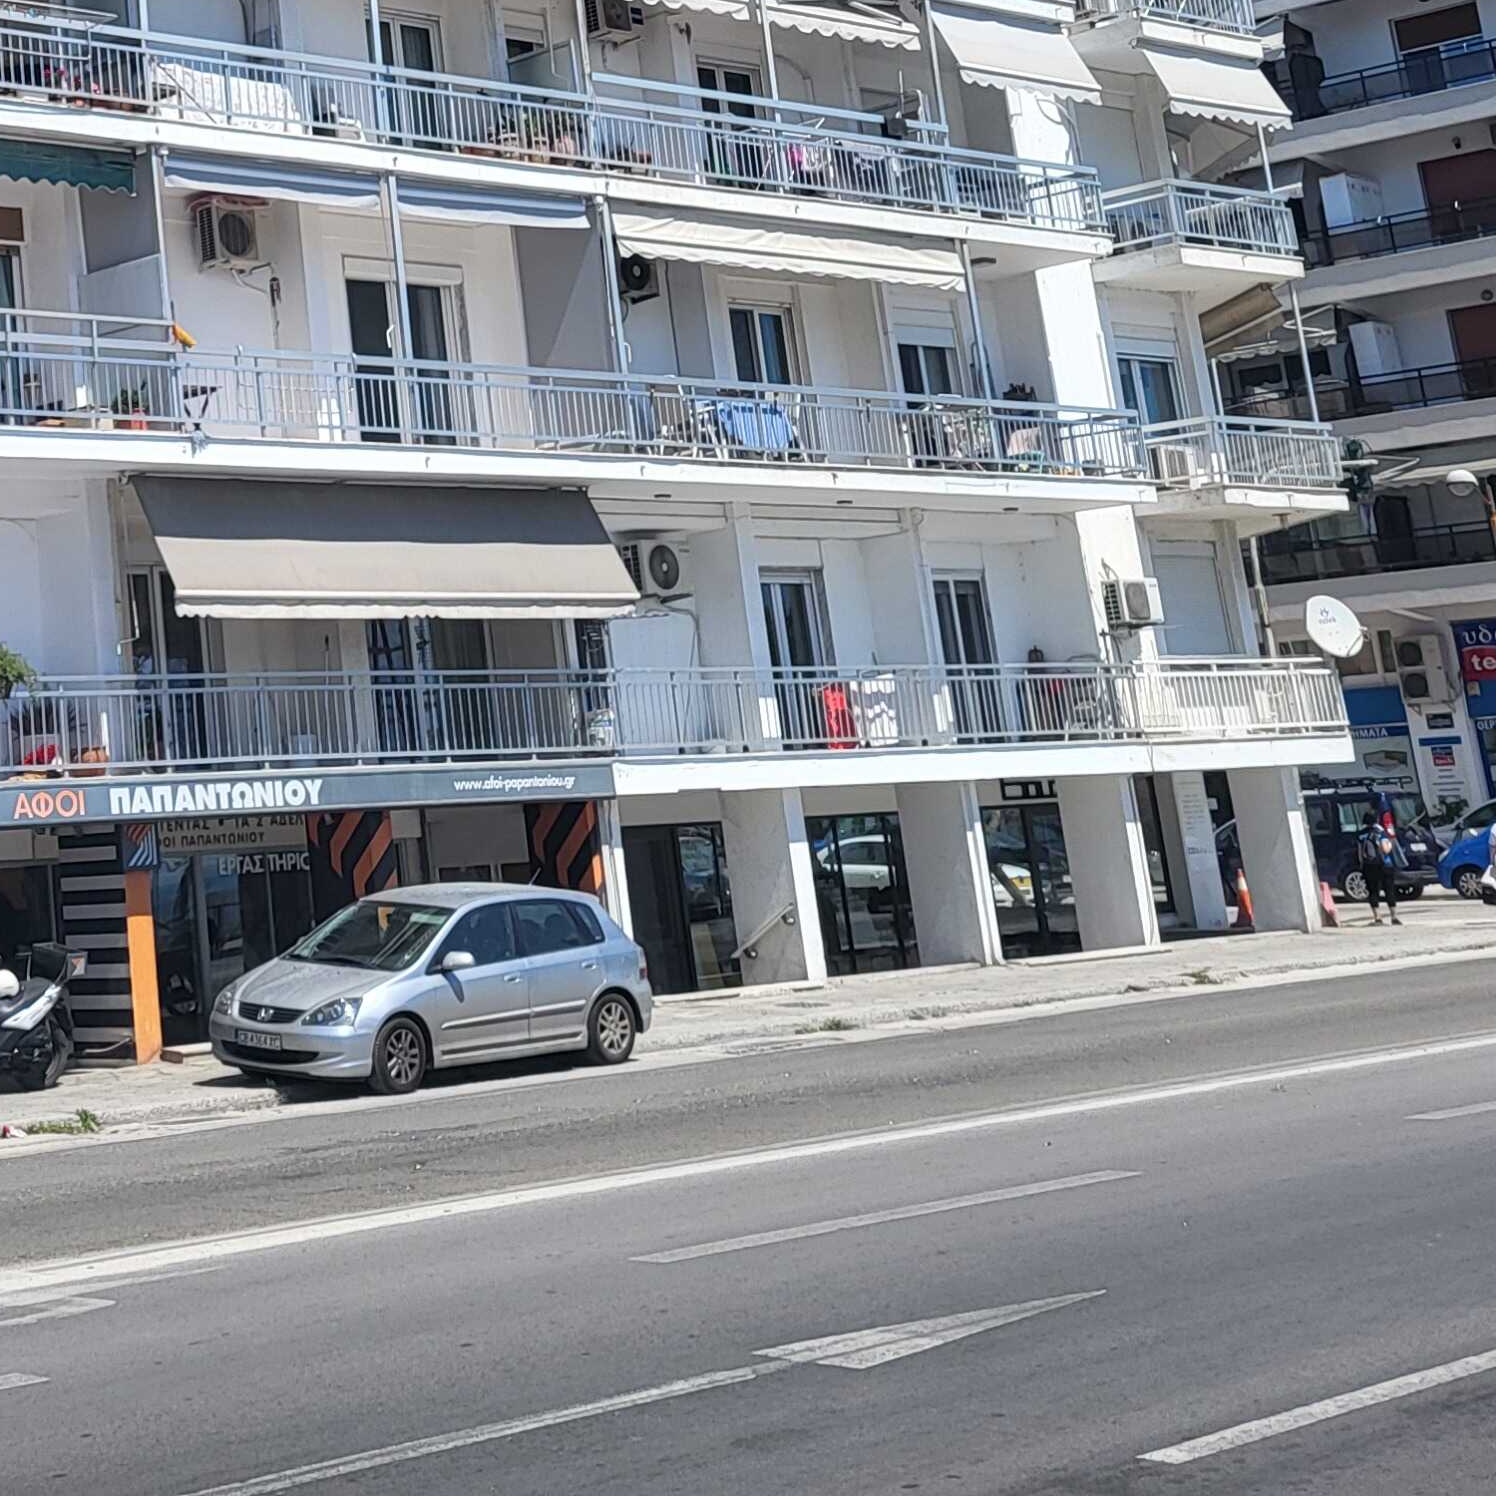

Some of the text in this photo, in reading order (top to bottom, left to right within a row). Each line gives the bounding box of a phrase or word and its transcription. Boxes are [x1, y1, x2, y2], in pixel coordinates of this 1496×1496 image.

[453, 773, 576, 792] www.afoi-papantoniou.gr
[13, 779, 323, 820] ΑΦΟΙ ΠΑΠΑΝΤΩΝΙΟΥ
[158, 831, 265, 849] ΟΙ ΠΑΠΑΝΤΩΝΙΟΥ
